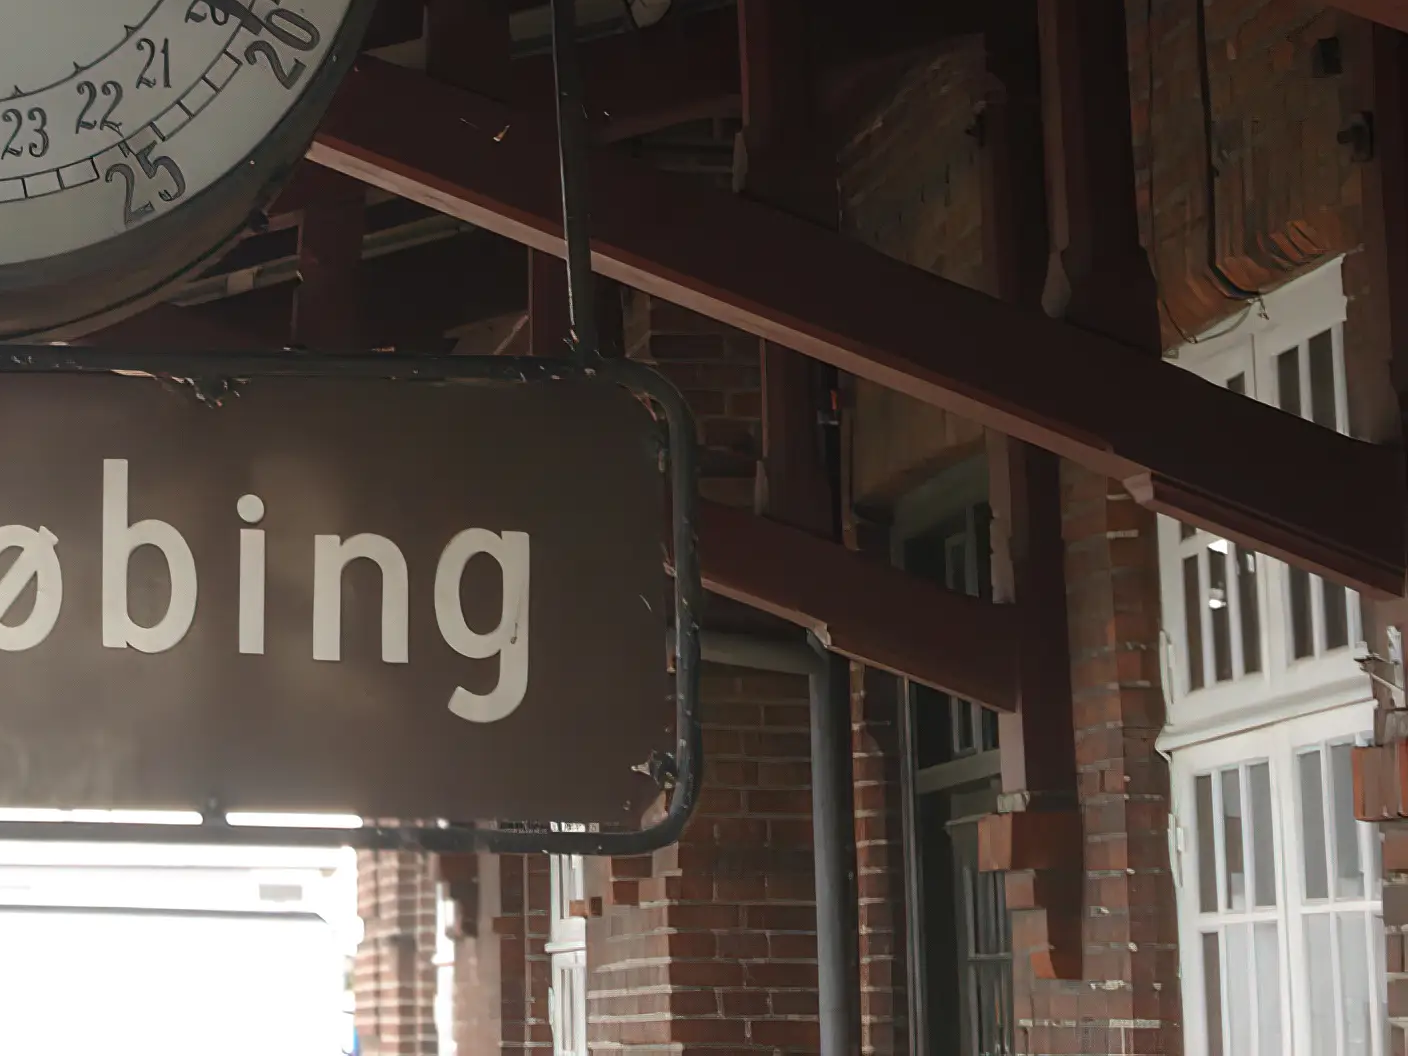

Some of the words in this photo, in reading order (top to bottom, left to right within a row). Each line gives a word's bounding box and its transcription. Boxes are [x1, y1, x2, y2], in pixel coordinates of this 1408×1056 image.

[135, 37, 172, 89] 21
[243, 7, 321, 90] 20
[1, 106, 50, 160] 23
[75, 80, 124, 134] 22
[104, 141, 187, 225] 25
